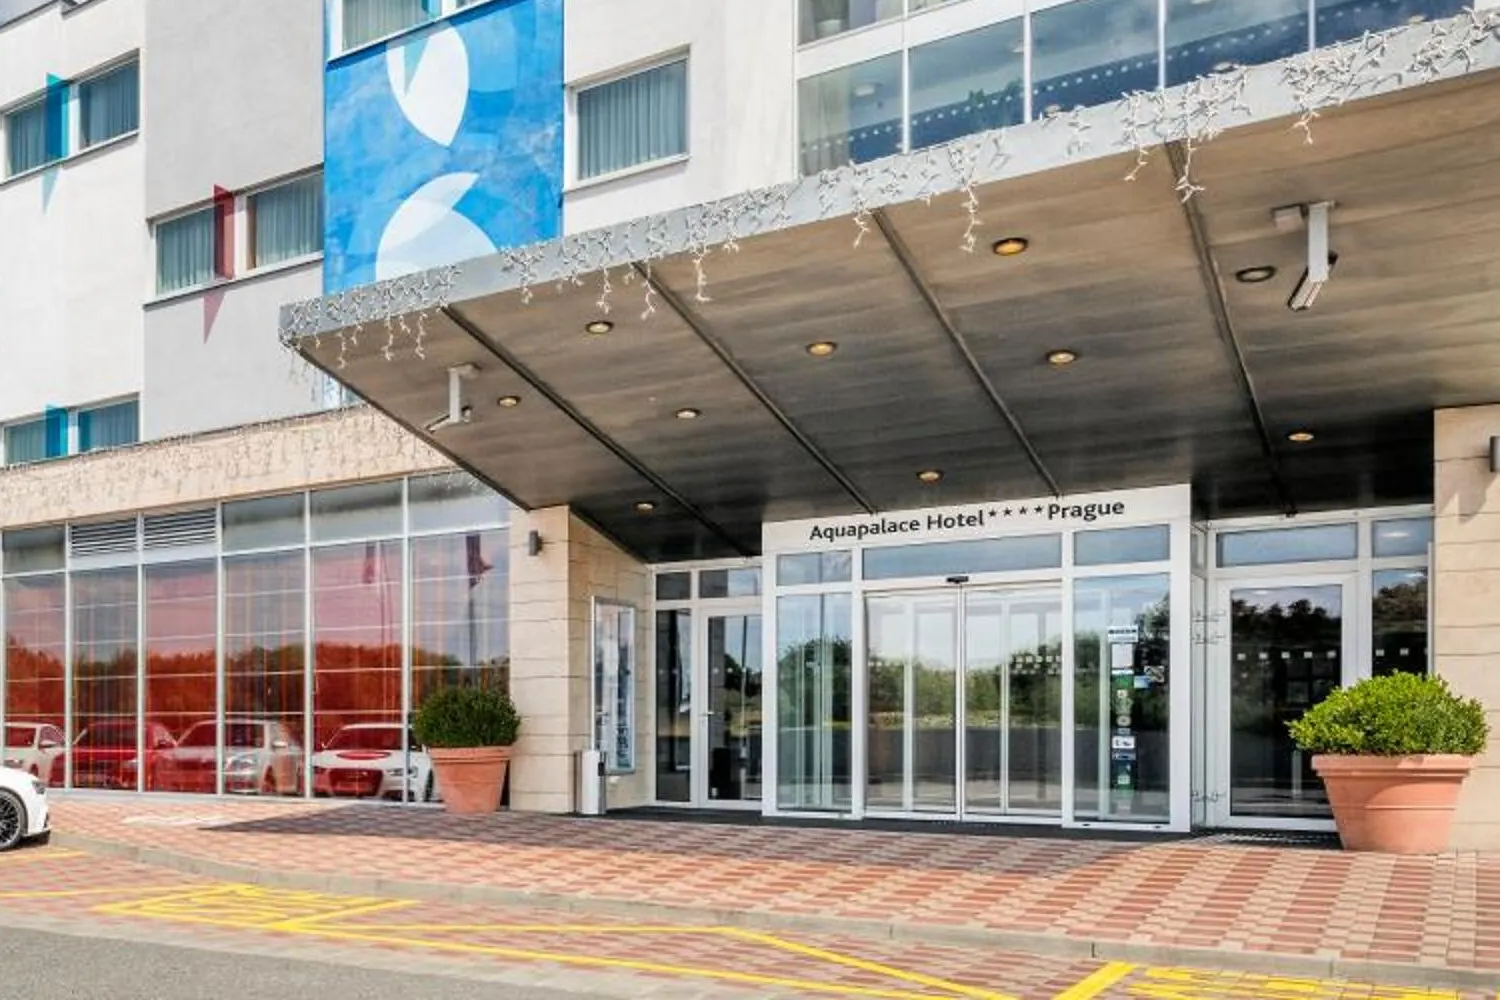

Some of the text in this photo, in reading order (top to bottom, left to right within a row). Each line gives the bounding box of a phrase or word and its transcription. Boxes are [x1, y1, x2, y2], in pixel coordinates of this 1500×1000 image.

[809, 500, 1125, 541] Aquapalace Hotel Prague
